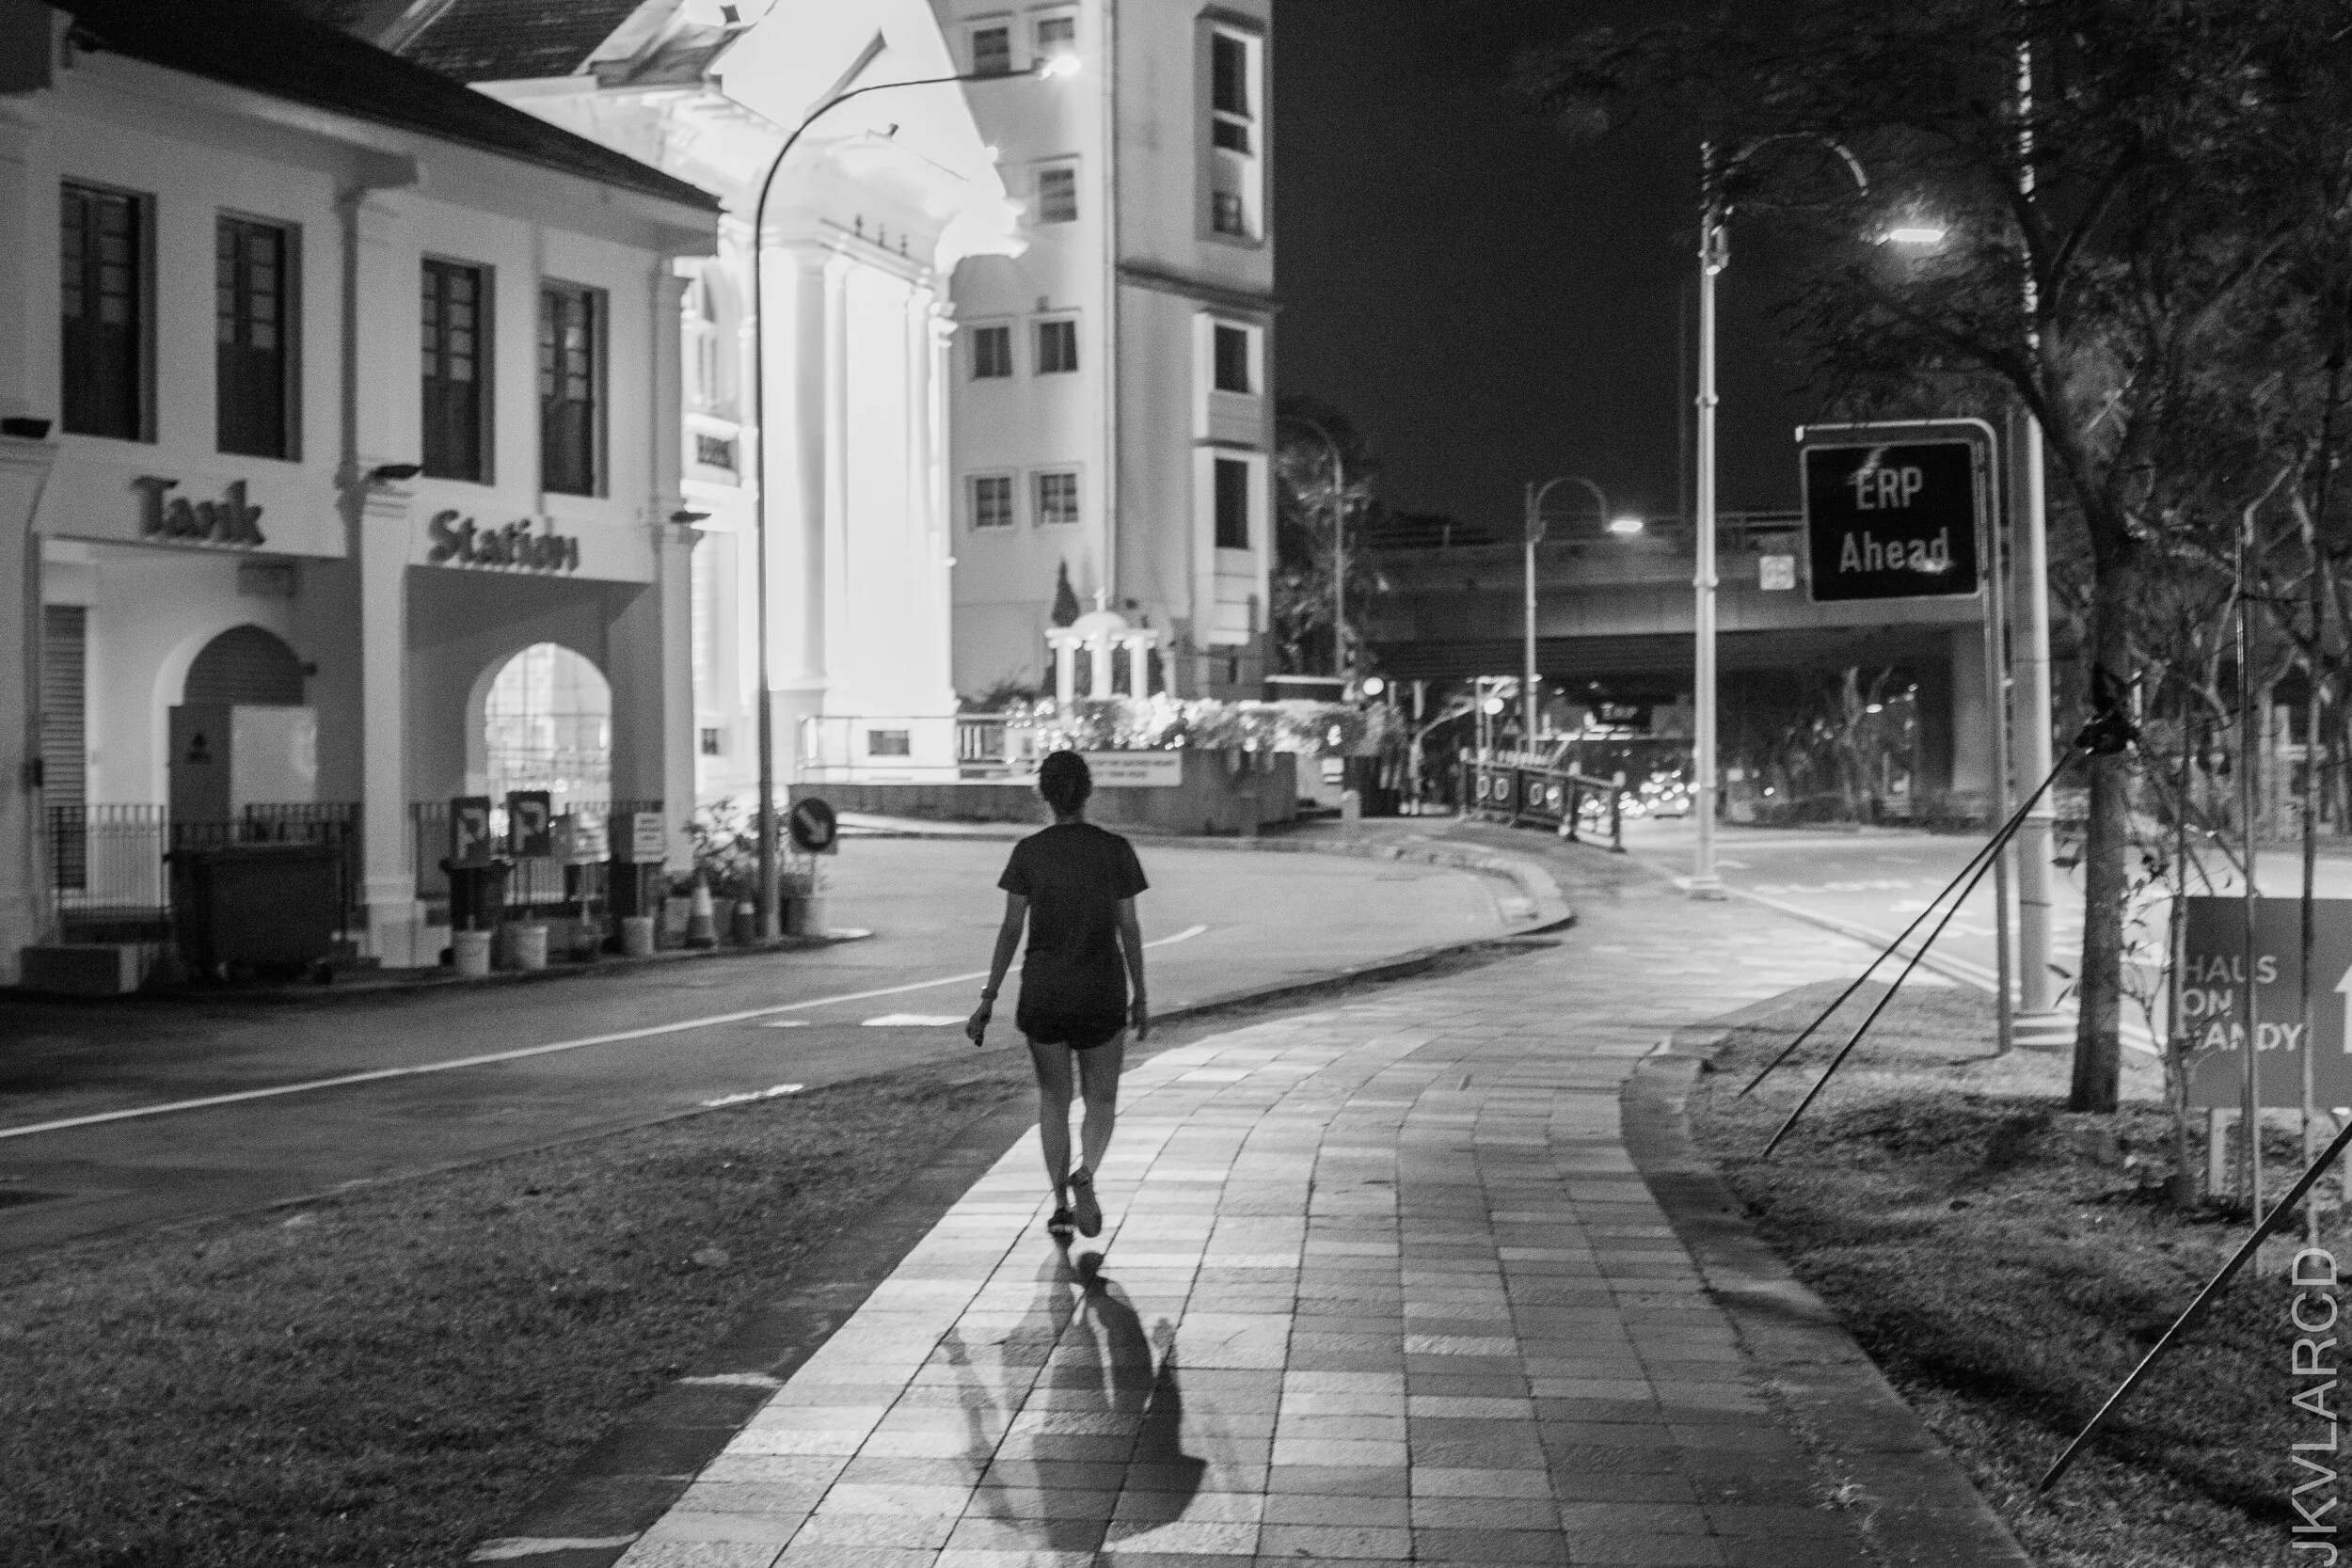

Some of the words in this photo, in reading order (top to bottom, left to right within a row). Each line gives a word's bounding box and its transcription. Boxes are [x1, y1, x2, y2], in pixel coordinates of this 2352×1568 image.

[1854, 466, 1923, 510] ERP
[426, 509, 580, 572] Station
[1839, 526, 1950, 575] Ahead
[2183, 988, 2233, 1018] ON
